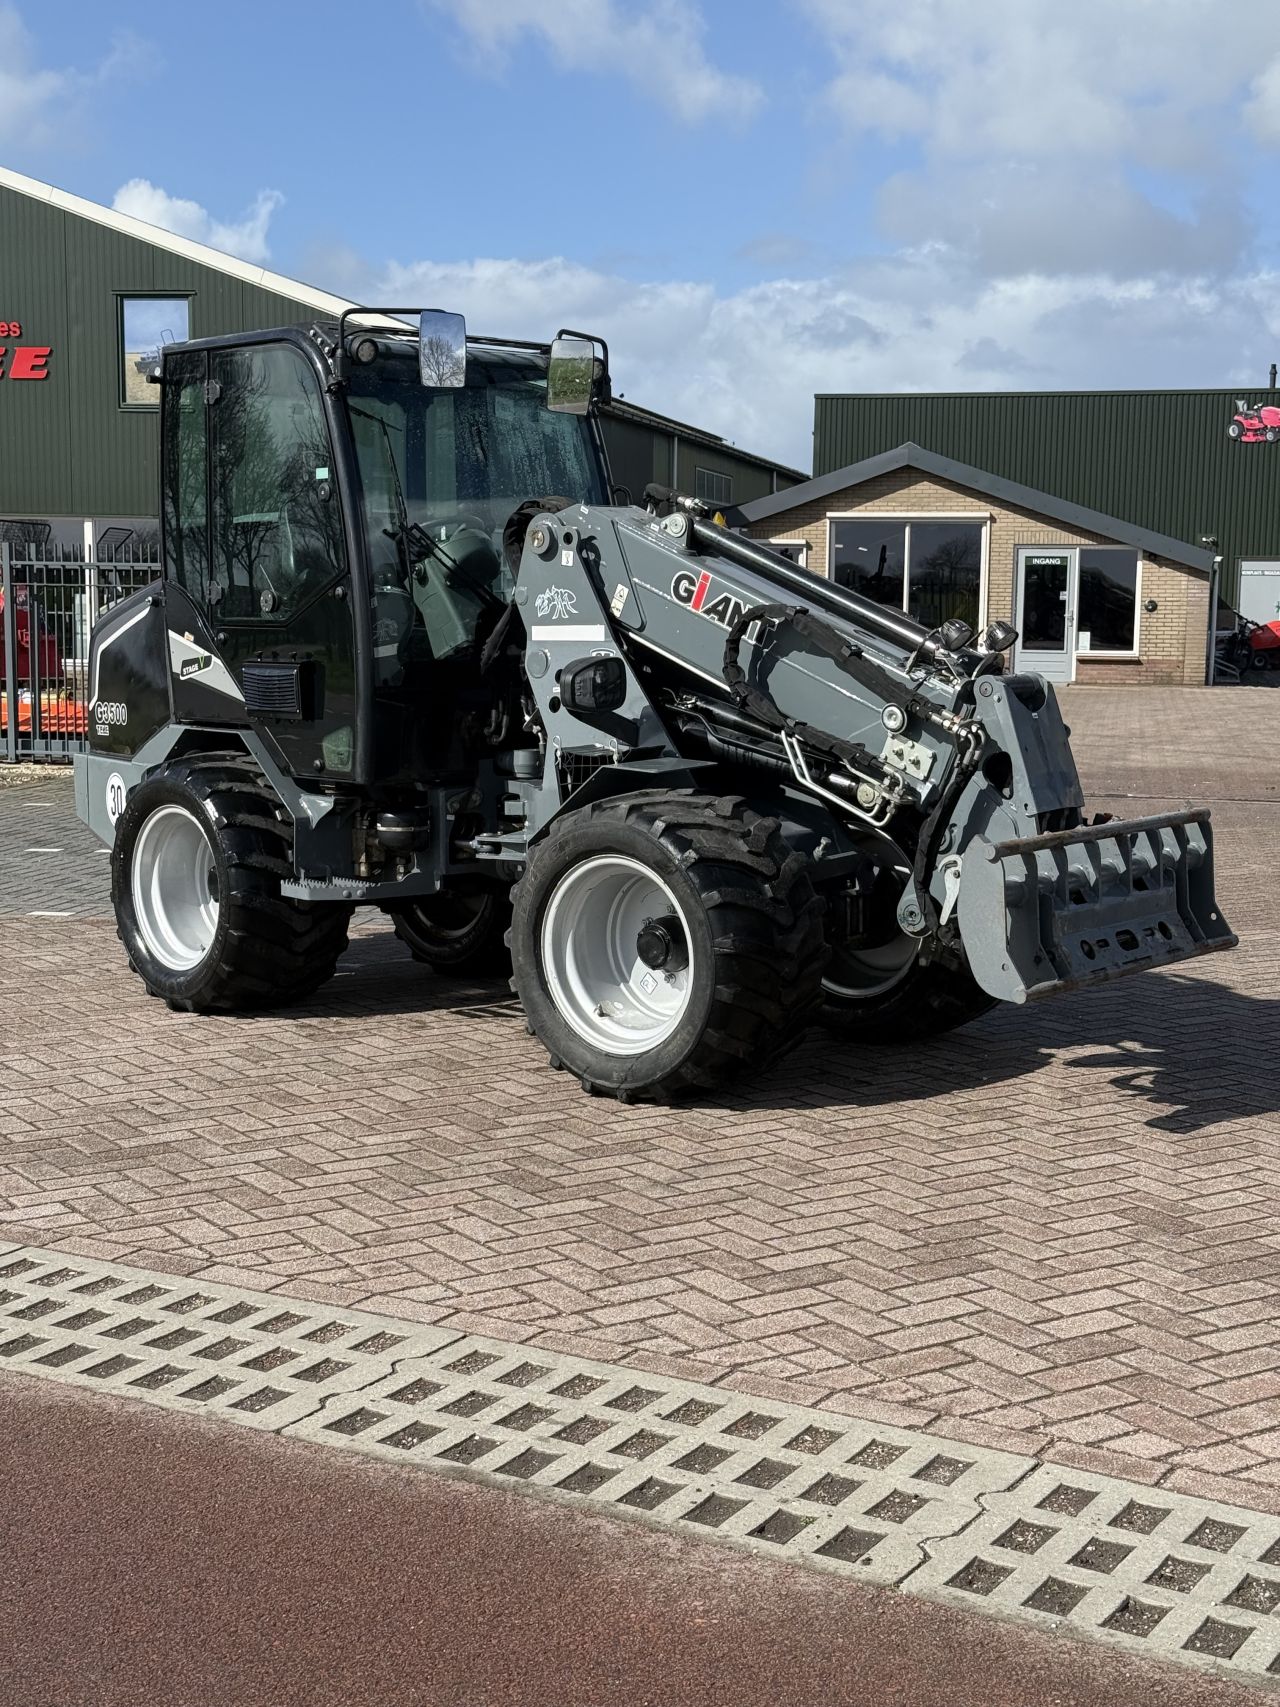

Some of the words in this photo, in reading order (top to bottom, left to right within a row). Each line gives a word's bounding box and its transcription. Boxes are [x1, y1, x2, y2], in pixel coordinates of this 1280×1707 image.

[182, 663, 199, 675] STAGE
[198, 655, 205, 669] V
[95, 701, 128, 726] G3500
[110, 784, 123, 817] 30
